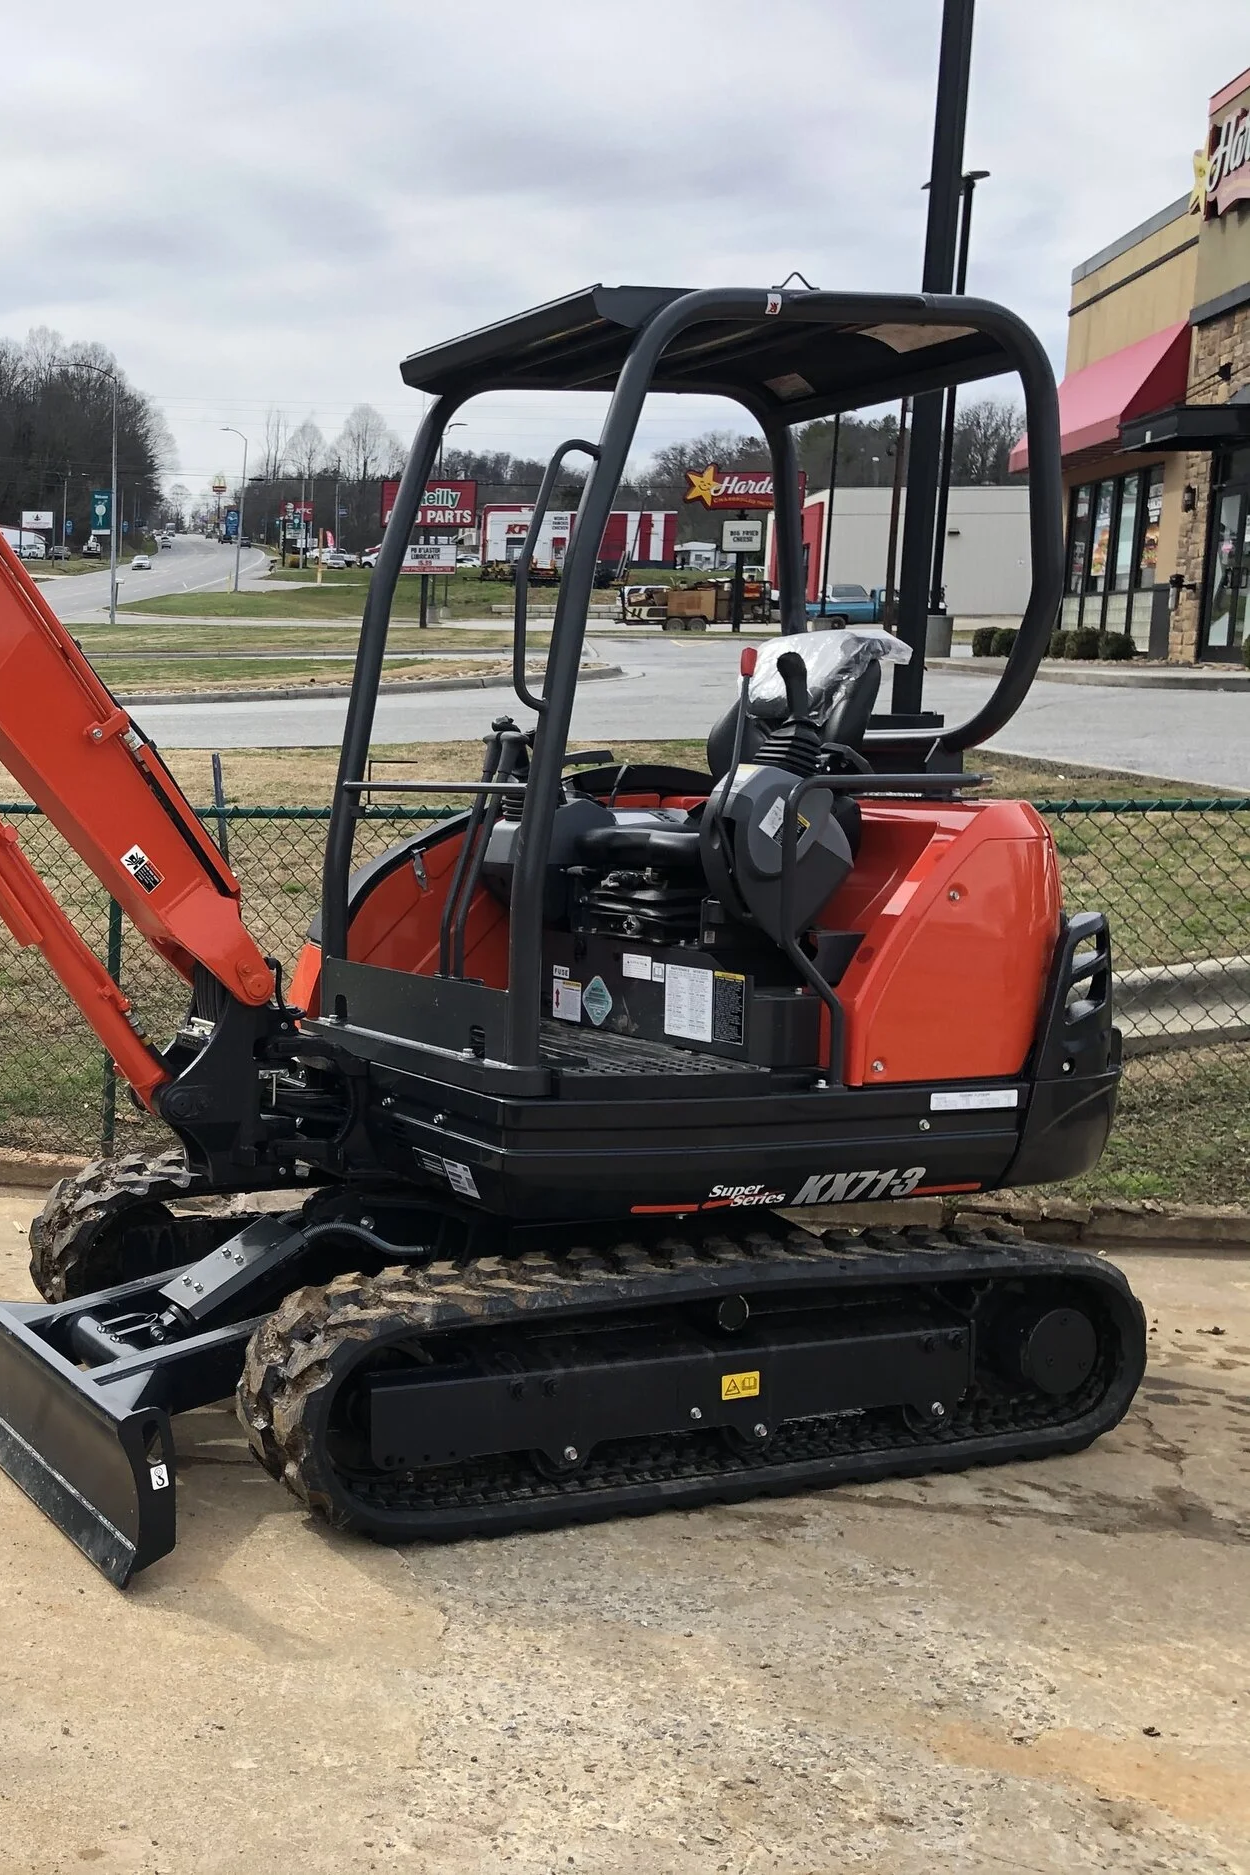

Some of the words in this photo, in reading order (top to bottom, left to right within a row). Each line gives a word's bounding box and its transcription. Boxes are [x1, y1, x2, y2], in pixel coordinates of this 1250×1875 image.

[711, 476, 774, 496] Hard
[426, 510, 472, 523] PARTS
[505, 524, 529, 535] KF
[554, 967, 569, 977] FUSE
[708, 1184, 765, 1199] Super
[789, 1166, 927, 1206] KX71-3
[730, 1191, 786, 1207] Series
